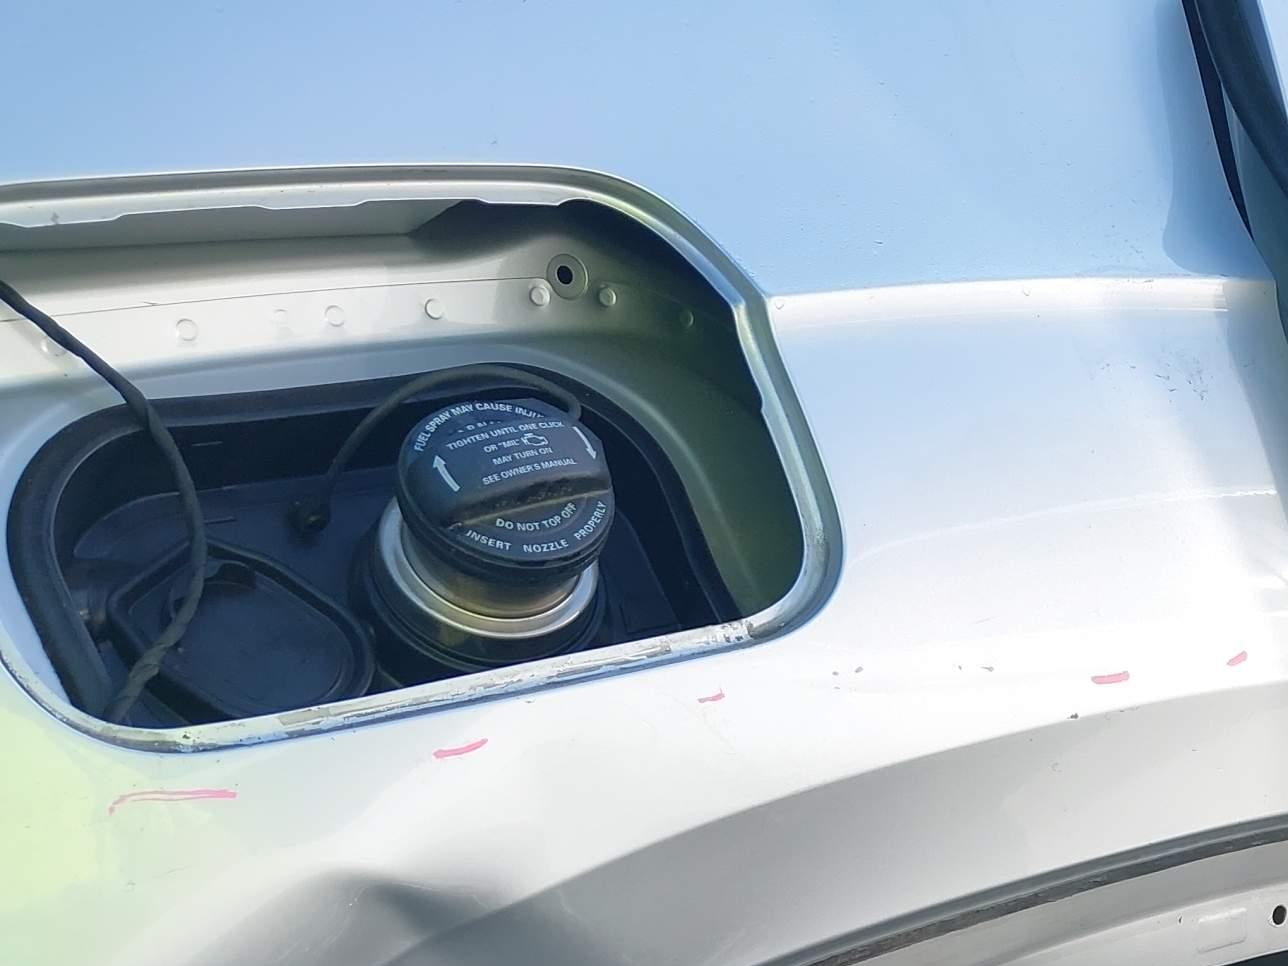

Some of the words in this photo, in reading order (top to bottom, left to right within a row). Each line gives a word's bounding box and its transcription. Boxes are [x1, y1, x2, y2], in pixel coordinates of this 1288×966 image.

[414, 431, 431, 452] FUEL
[426, 410, 451, 432] SPRAY
[451, 404, 474, 416] MAY
[476, 403, 512, 412] CAUSE
[446, 432, 489, 450] TIGHTEN
[490, 426, 518, 438] UNTIL
[518, 422, 538, 431] ONE
[538, 421, 565, 429] CLICK
[483, 444, 497, 453] OR
[493, 455, 513, 465] MAY
[513, 451, 539, 460] TURN
[482, 474, 501, 485] SEE
[501, 464, 541, 479] OWNER'S
[542, 458, 577, 470] MANUAL
[465, 530, 512, 550] INSERT
[523, 539, 569, 553] NOZZLE
[574, 501, 606, 540] PROPERLY
[496, 518, 514, 529] DO
[516, 523, 540, 531] NOT
[542, 517, 561, 529] TOP
[561, 502, 576, 518] OFF
